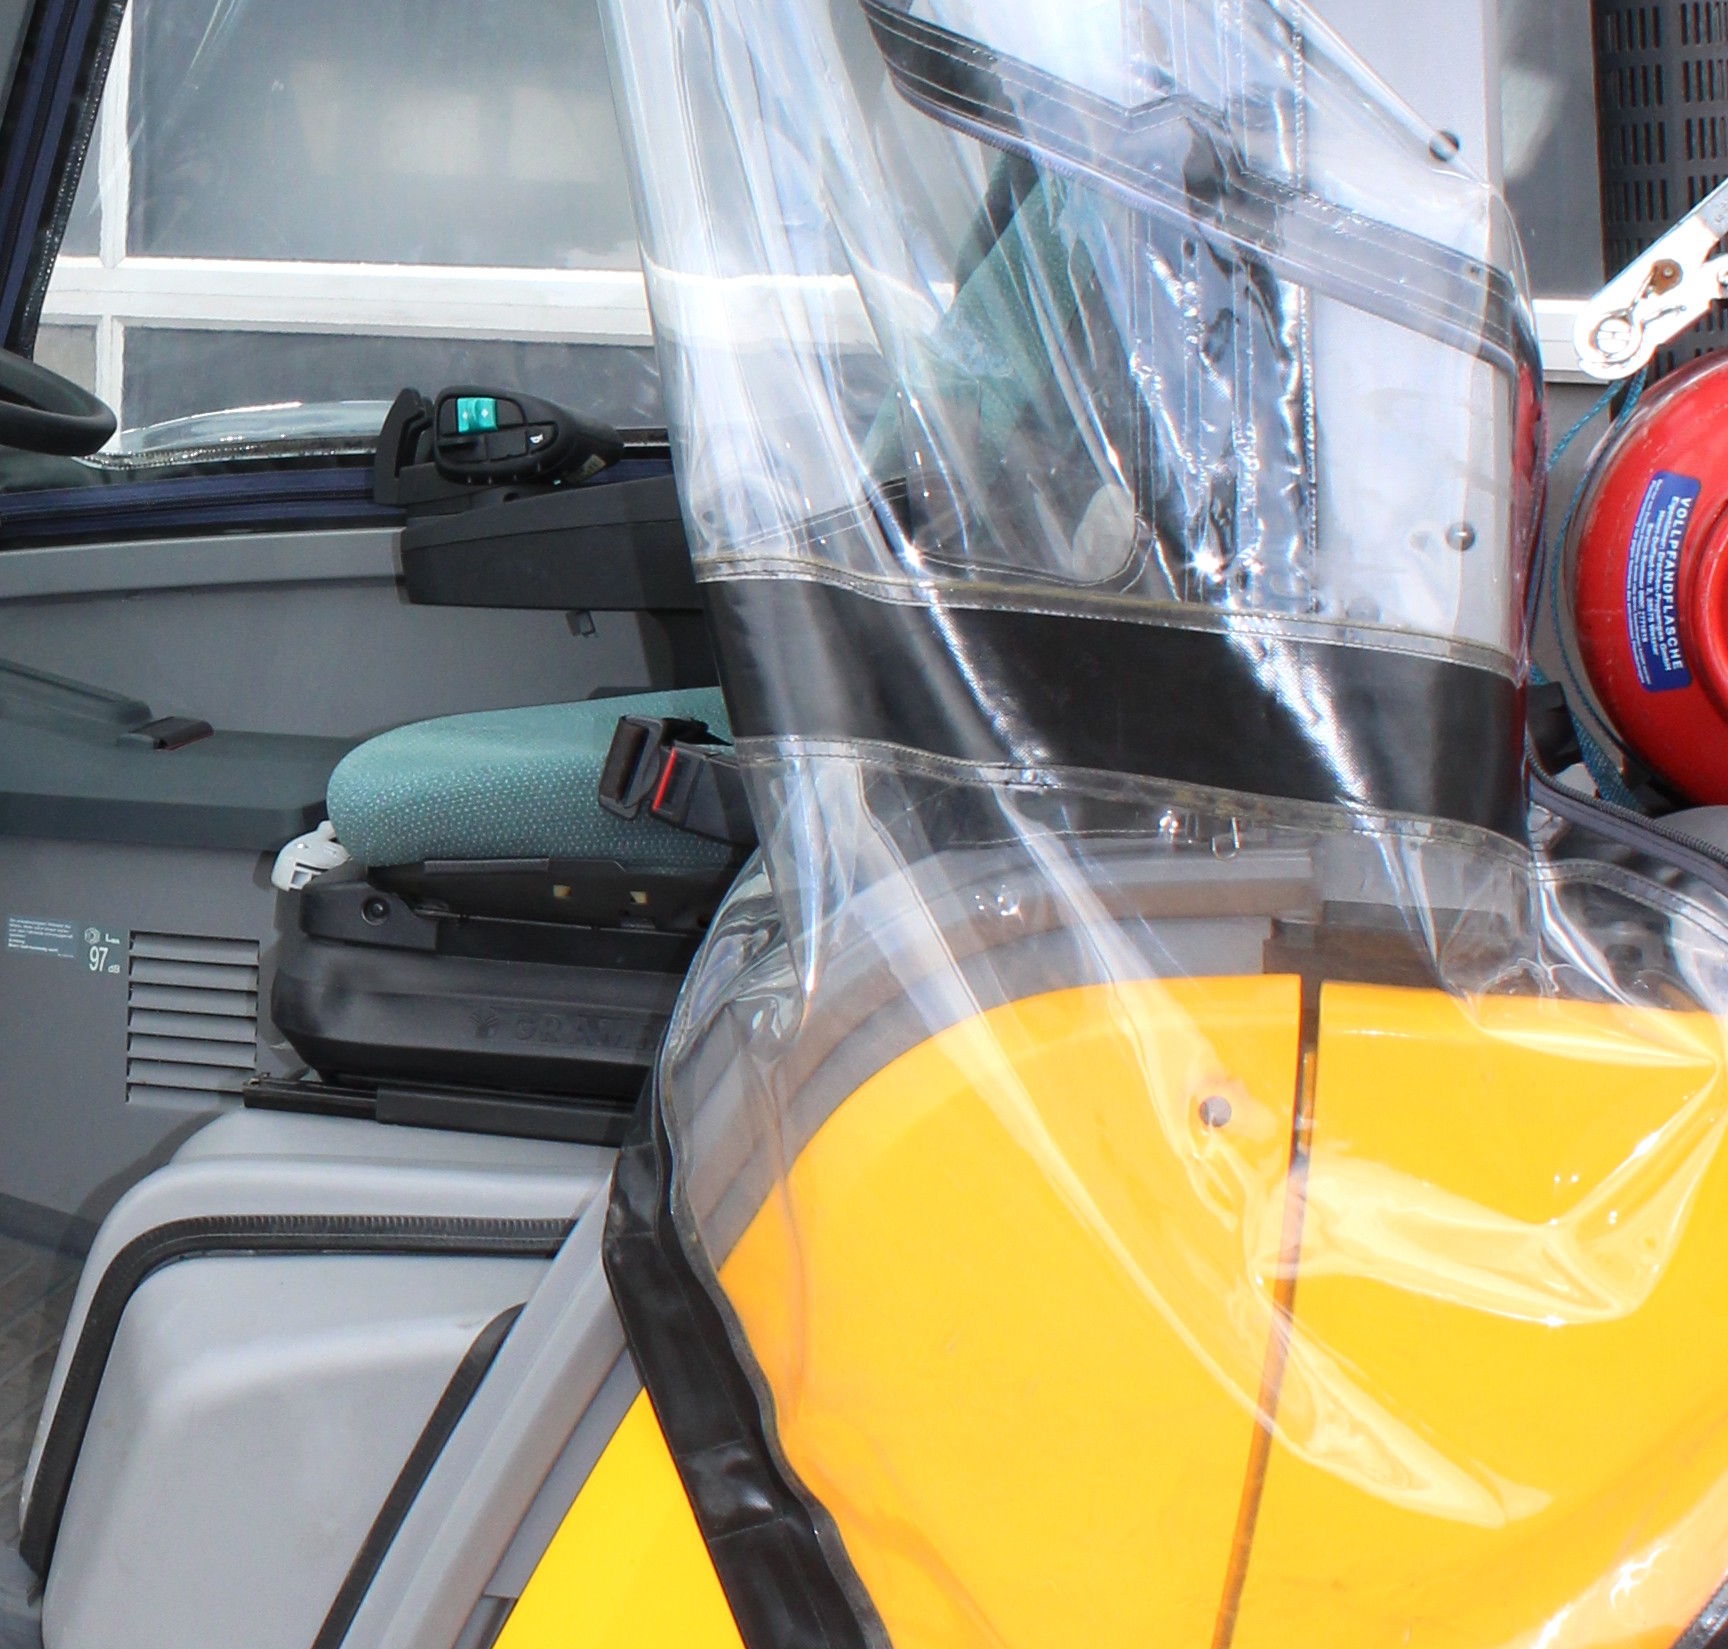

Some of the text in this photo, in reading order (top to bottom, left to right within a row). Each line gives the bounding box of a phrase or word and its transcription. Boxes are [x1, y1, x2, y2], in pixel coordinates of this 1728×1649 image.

[1661, 497, 1692, 670] VOLLPFANDFLASCHE
[89, 946, 109, 972] 97
[108, 963, 120, 974] dB
